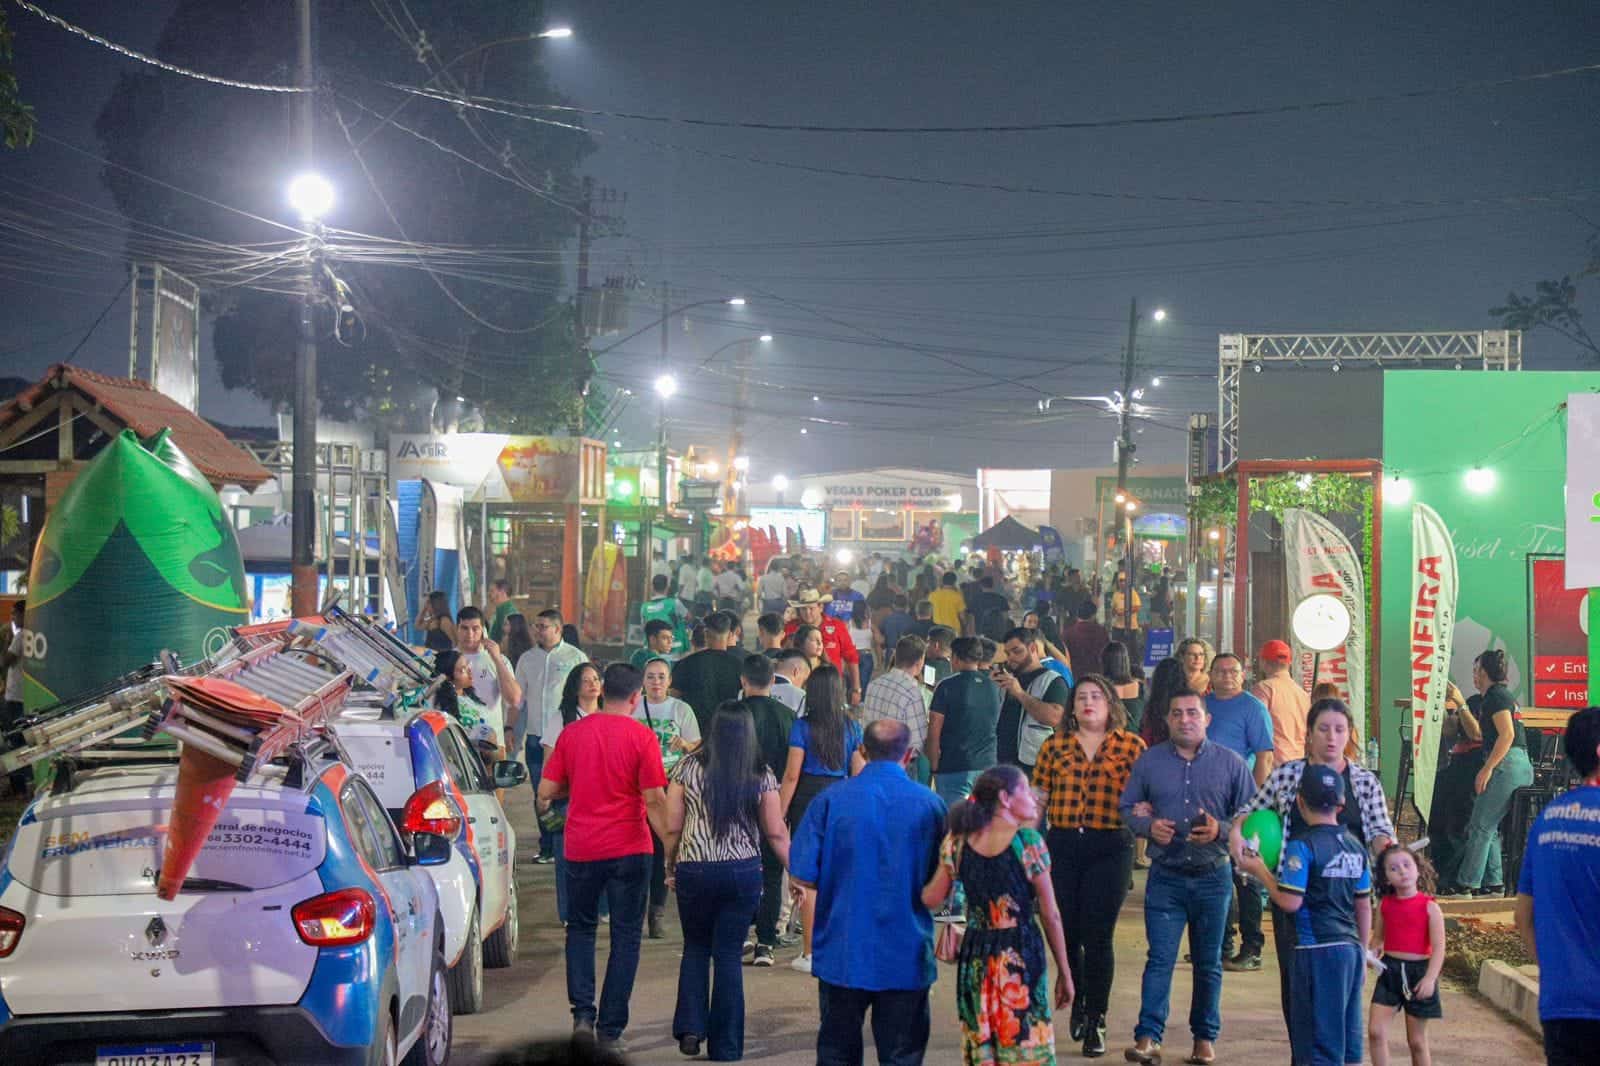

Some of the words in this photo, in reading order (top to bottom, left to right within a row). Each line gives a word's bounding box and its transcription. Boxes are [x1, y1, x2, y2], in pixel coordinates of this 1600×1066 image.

[825, 486, 863, 496] VEGAS
[867, 486, 906, 496] POKER
[910, 486, 942, 496] CLUB
[241, 823, 257, 832] de
[42, 835, 159, 859] FRONTEIRAS
[46, 831, 89, 848] SEM
[223, 833, 313, 851] 3302-4444
